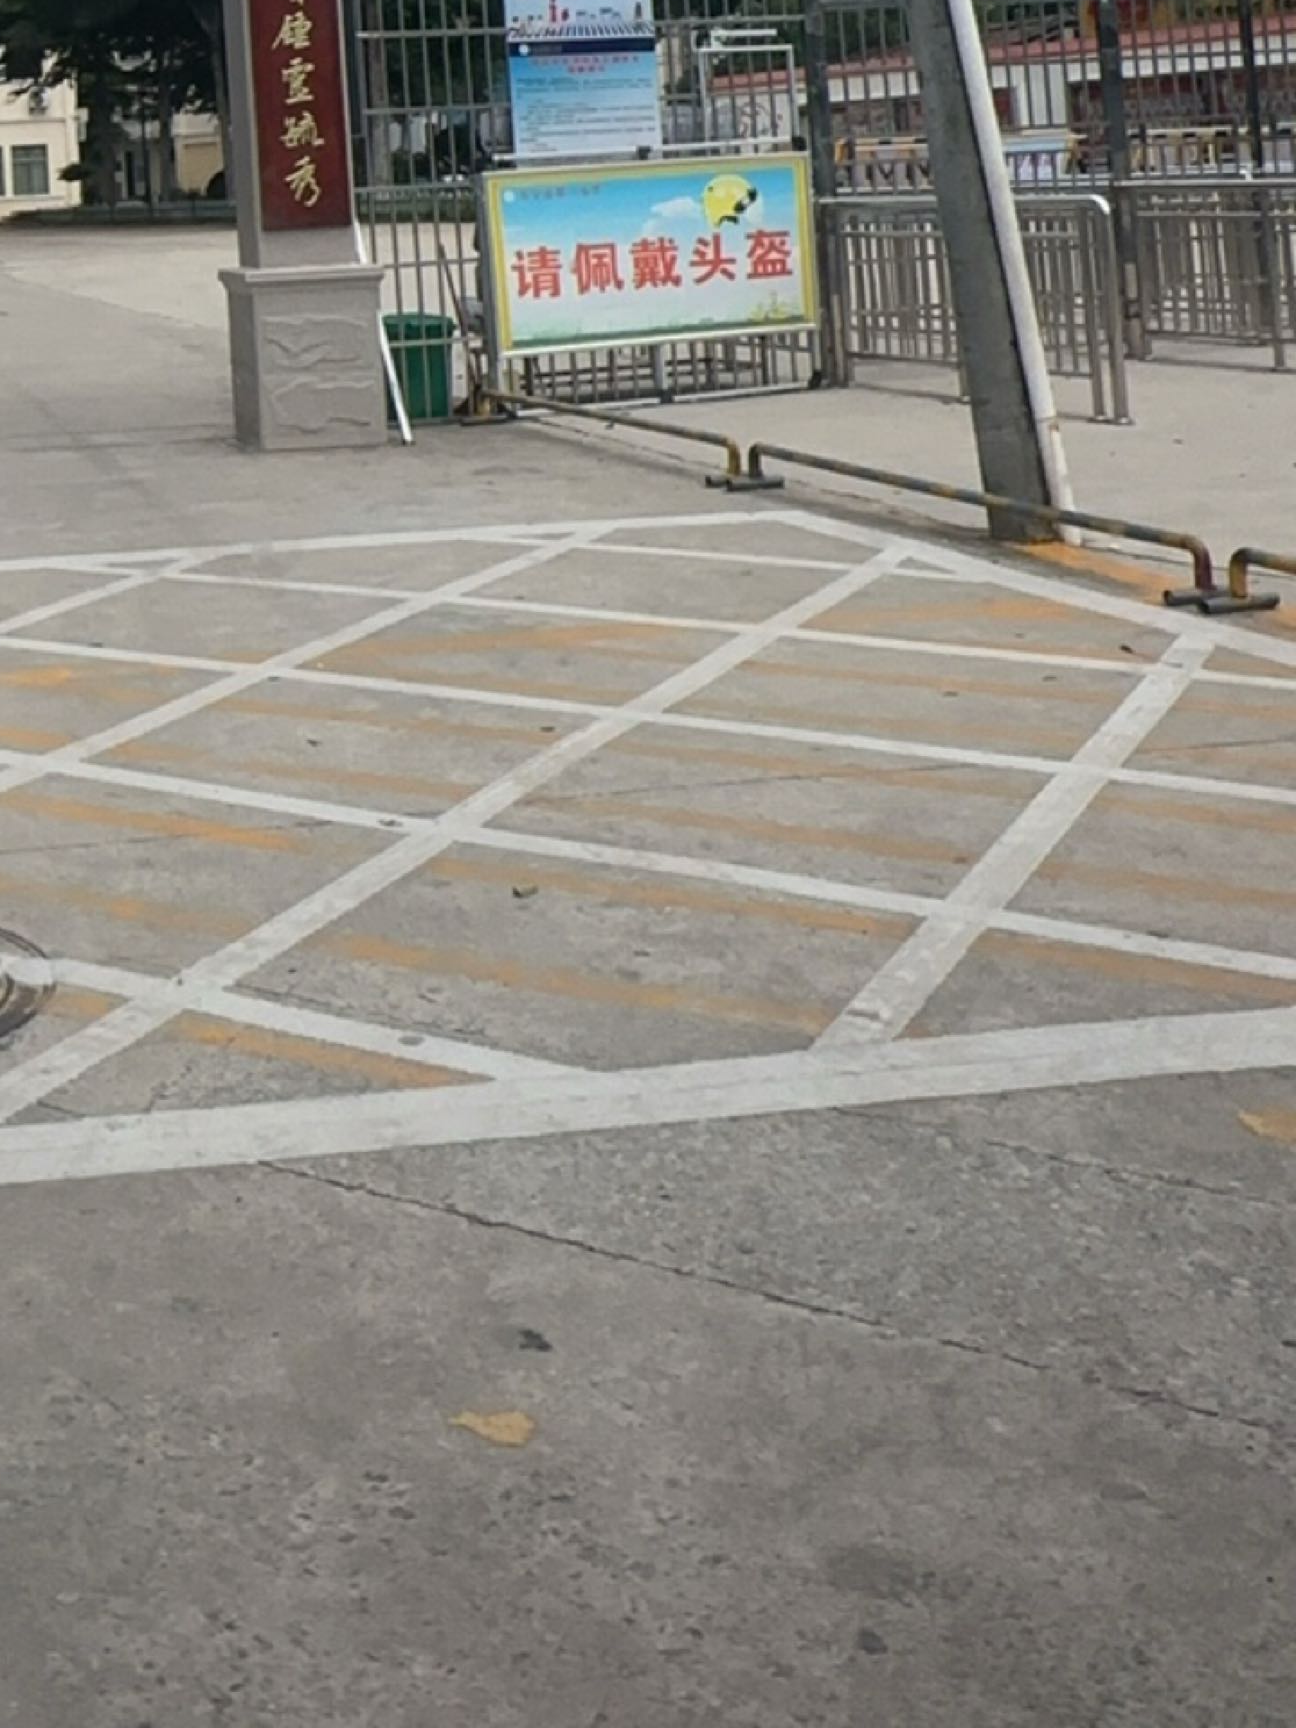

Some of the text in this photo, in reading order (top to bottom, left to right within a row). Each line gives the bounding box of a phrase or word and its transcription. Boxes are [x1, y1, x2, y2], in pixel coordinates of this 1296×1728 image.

[510, 228, 793, 299] 请佩戴头盔
